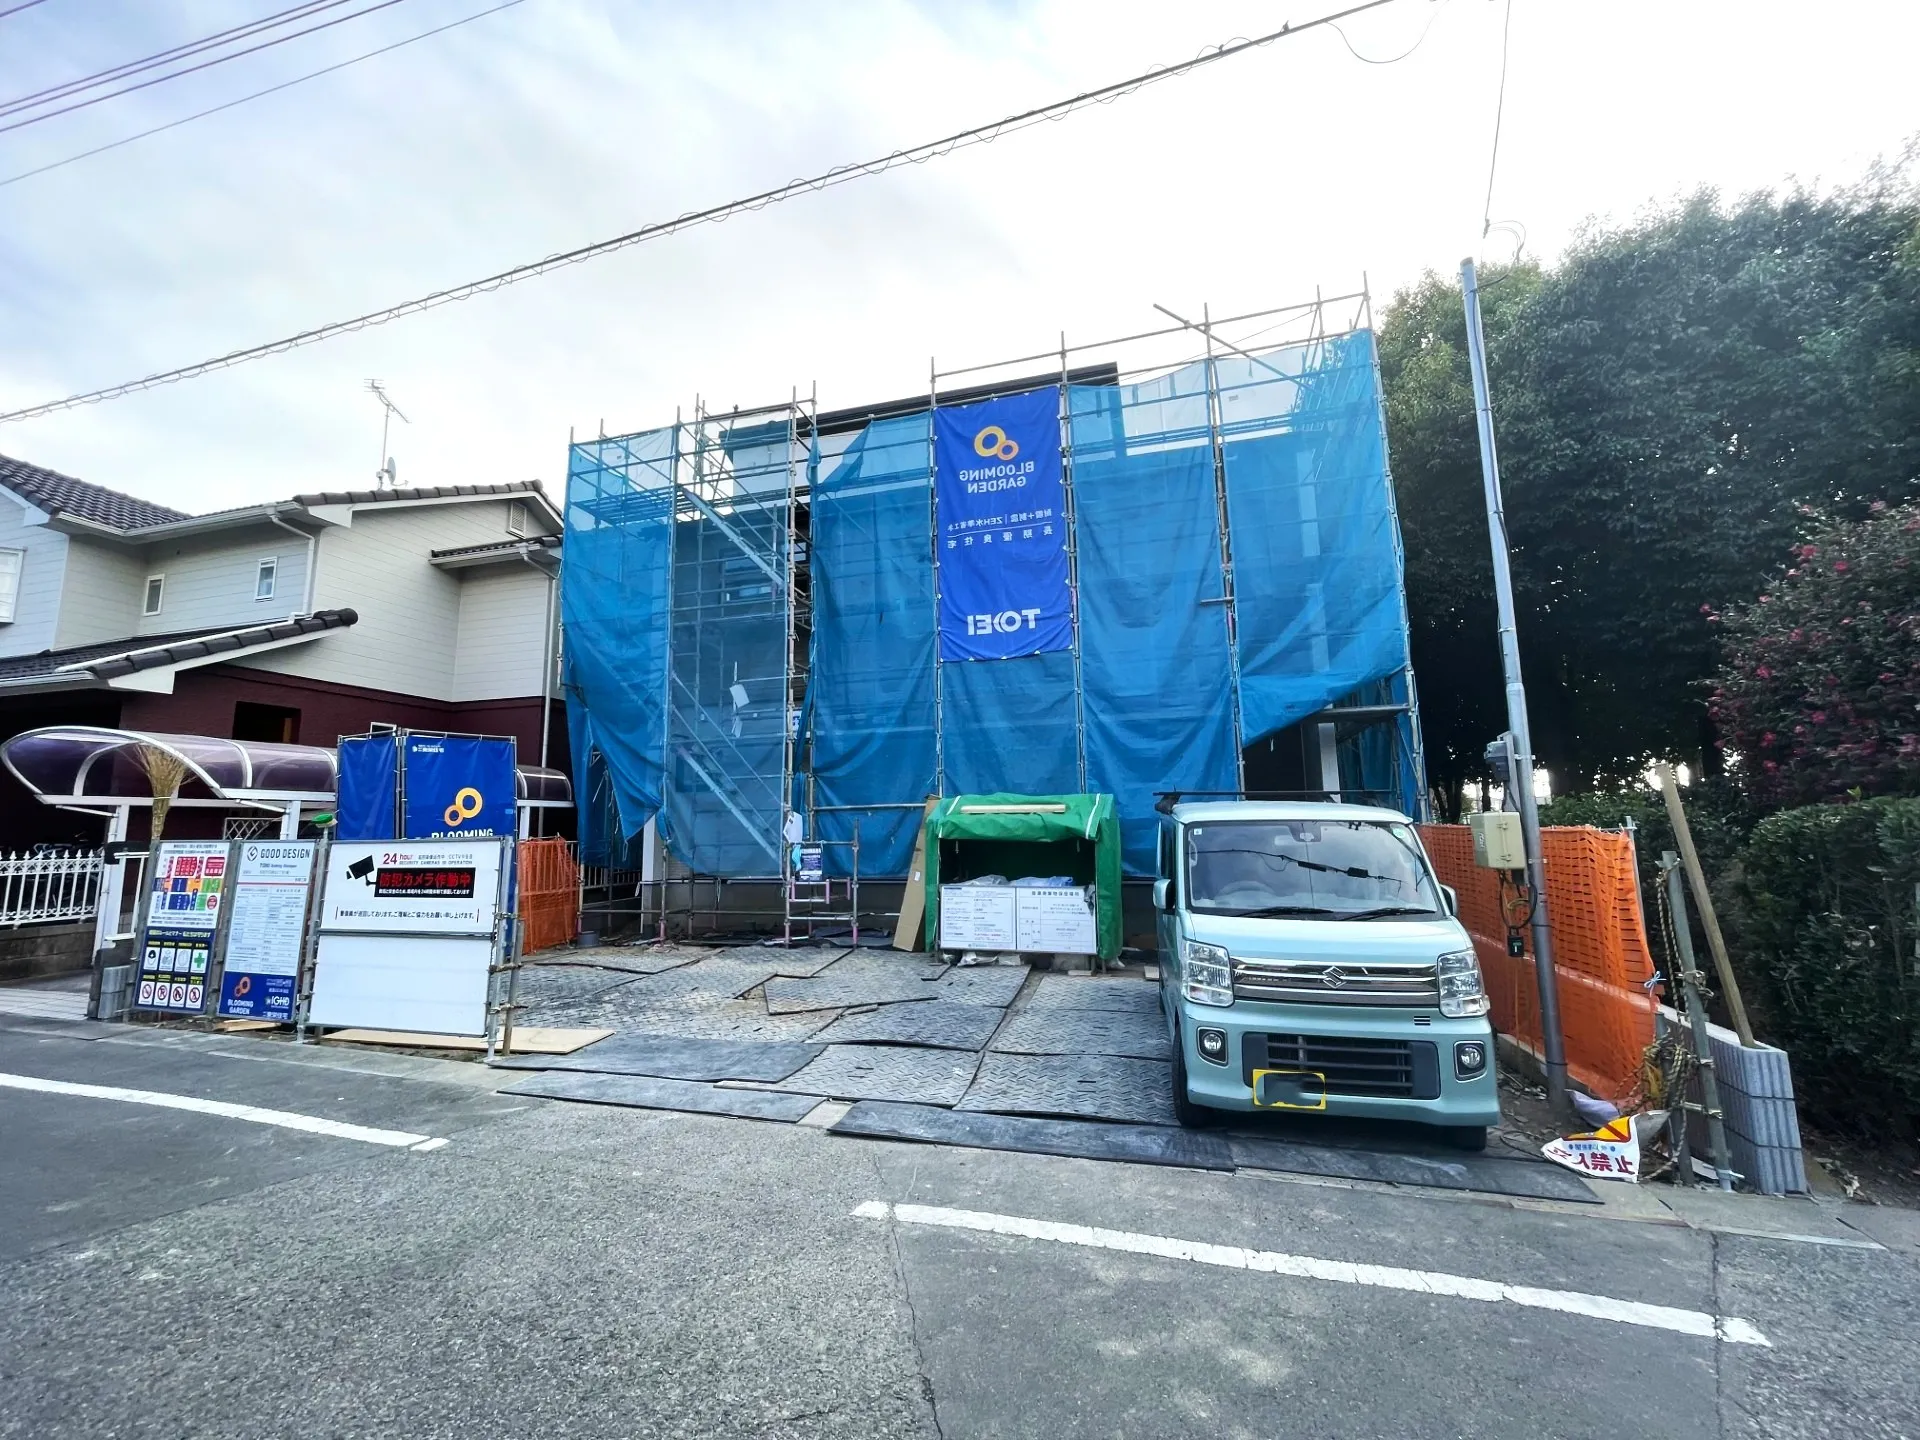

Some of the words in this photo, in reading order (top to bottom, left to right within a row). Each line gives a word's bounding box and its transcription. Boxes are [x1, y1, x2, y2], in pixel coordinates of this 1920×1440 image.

[260, 849, 280, 859] GOOD
[282, 849, 311, 859] DESIGN
[382, 853, 398, 865] 24
[379, 873, 471, 888] 防犯カメラ作動中
[227, 999, 254, 1008] BLOOMING
[229, 1006, 250, 1015] GARDEN
